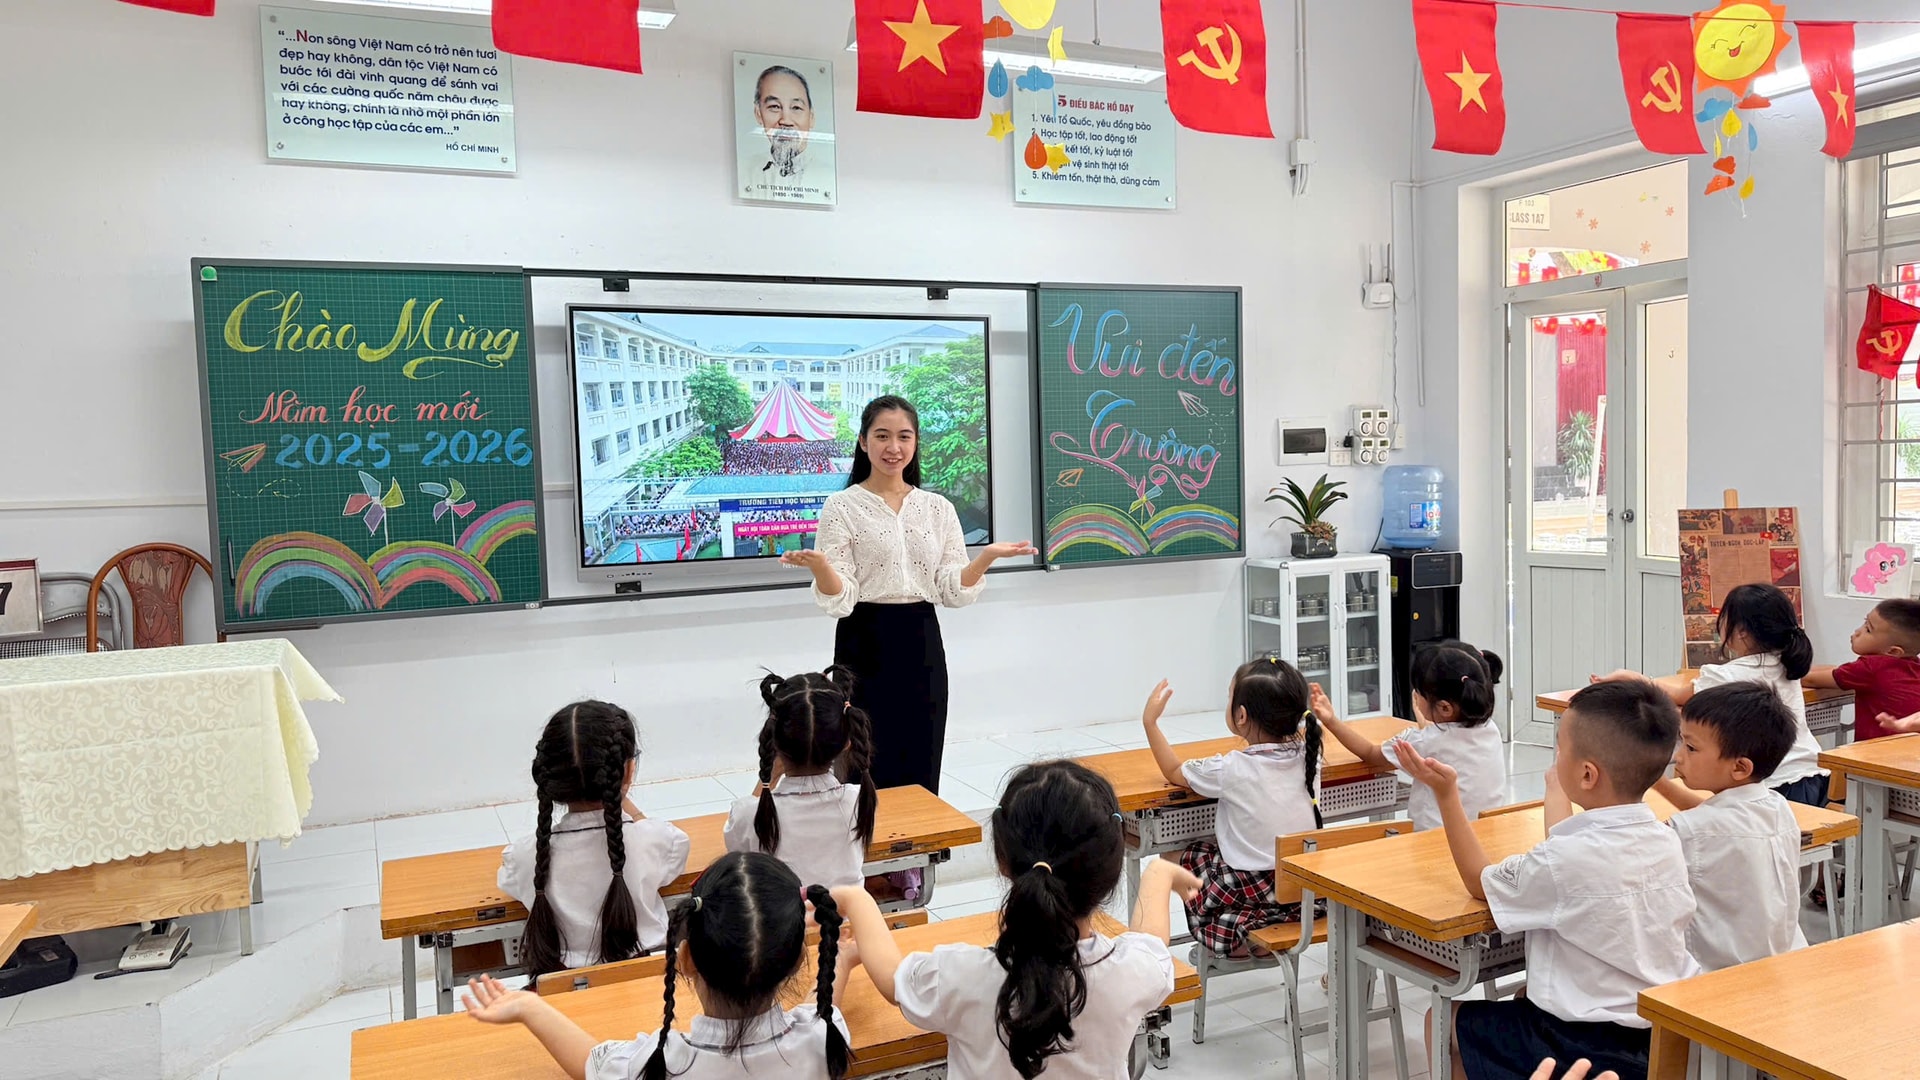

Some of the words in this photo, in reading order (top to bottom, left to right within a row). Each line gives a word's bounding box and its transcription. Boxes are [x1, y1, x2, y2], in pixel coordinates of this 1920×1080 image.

[327, 36, 356, 49] sông
[359, 38, 383, 51] Việt
[386, 41, 413, 52] Nam
[416, 44, 432, 54] có
[435, 45, 449, 55] trở
[452, 47, 473, 57] nên
[477, 49, 497, 60] tươi
[279, 48, 304, 60] đẹp
[308, 50, 330, 63] hay
[334, 53, 376, 68] không,
[379, 58, 402, 68] dân
[405, 59, 424, 71] tộc
[427, 61, 450, 73] Việt
[453, 63, 480, 75] Nam
[483, 66, 498, 76] có
[280, 65, 312, 76] bước
[317, 67, 332, 78] tới
[336, 69, 356, 80] đài
[360, 72, 384, 82] vinh
[389, 75, 427, 88] quang
[431, 76, 447, 87] để
[451, 79, 477, 90] sánh
[482, 82, 498, 92] vai
[281, 81, 299, 92] với
[303, 83, 327, 94] các
[331, 86, 370, 98] cường
[374, 88, 404, 99] quốc
[408, 92, 434, 102] năm
[437, 94, 466, 104] châu
[470, 96, 499, 108] được
[1058, 95, 1067, 107] 5
[1070, 98, 1087, 109] ĐIỀU
[1090, 100, 1105, 110] BÁC
[1107, 101, 1117, 111] HỒ
[1120, 104, 1134, 114] DẠY
[282, 98, 305, 110] hay
[309, 100, 350, 114] không,
[353, 103, 385, 114] chính
[389, 106, 399, 115] là
[402, 107, 424, 117] nhờ
[427, 110, 448, 120] một
[451, 110, 480, 121] phần
[483, 112, 500, 122] lớn
[283, 113, 291, 124] ở
[293, 116, 325, 128] công
[328, 117, 351, 129] học
[353, 119, 373, 132] tập
[375, 120, 398, 131] của
[400, 123, 423, 133] các
[1032, 114, 1038, 122] 1.
[1040, 114, 1056, 124] Yêu
[1058, 114, 1068, 124] Tổ
[1070, 117, 1094, 127] Quốc,
[1096, 119, 1111, 128] yêu
[1113, 119, 1134, 131] đồng
[1136, 122, 1151, 131] bào
[1041, 129, 1057, 139] Học
[1060, 130, 1073, 140] tập
[1075, 131, 1088, 141] tốt,
[1090, 133, 1102, 141] lao
[1105, 133, 1125, 144] động
[1127, 135, 1137, 144] tốt
[461, 144, 476, 152] CHÍ
[478, 145, 499, 153] MINH
[1065, 144, 1078, 153] kết
[1080, 145, 1093, 155] tốt,
[1095, 146, 1104, 157] kỷ
[1106, 148, 1120, 158] luật
[1123, 148, 1133, 157] tốt
[1073, 160, 1082, 169] vệ
[1085, 161, 1100, 169] sinh
[1102, 161, 1116, 172] thật
[1119, 161, 1129, 171] tốt
[1033, 171, 1039, 179] 5.
[1042, 172, 1067, 181] Khiêm
[1069, 173, 1084, 183] tốn,
[1086, 175, 1101, 184] thật
[1104, 175, 1118, 185] thà,
[1120, 176, 1140, 187] dũng
[1142, 177, 1160, 186] cảm
[1532, 214, 1545, 224] 1A7
[224, 290, 357, 352] Chào
[358, 298, 519, 380] Mừng
[1048, 303, 1146, 378] Vui
[1159, 323, 1237, 396] đến
[239, 390, 331, 423] Năm
[340, 385, 401, 429] học
[414, 391, 494, 421] mới
[1050, 390, 1222, 500] Trường
